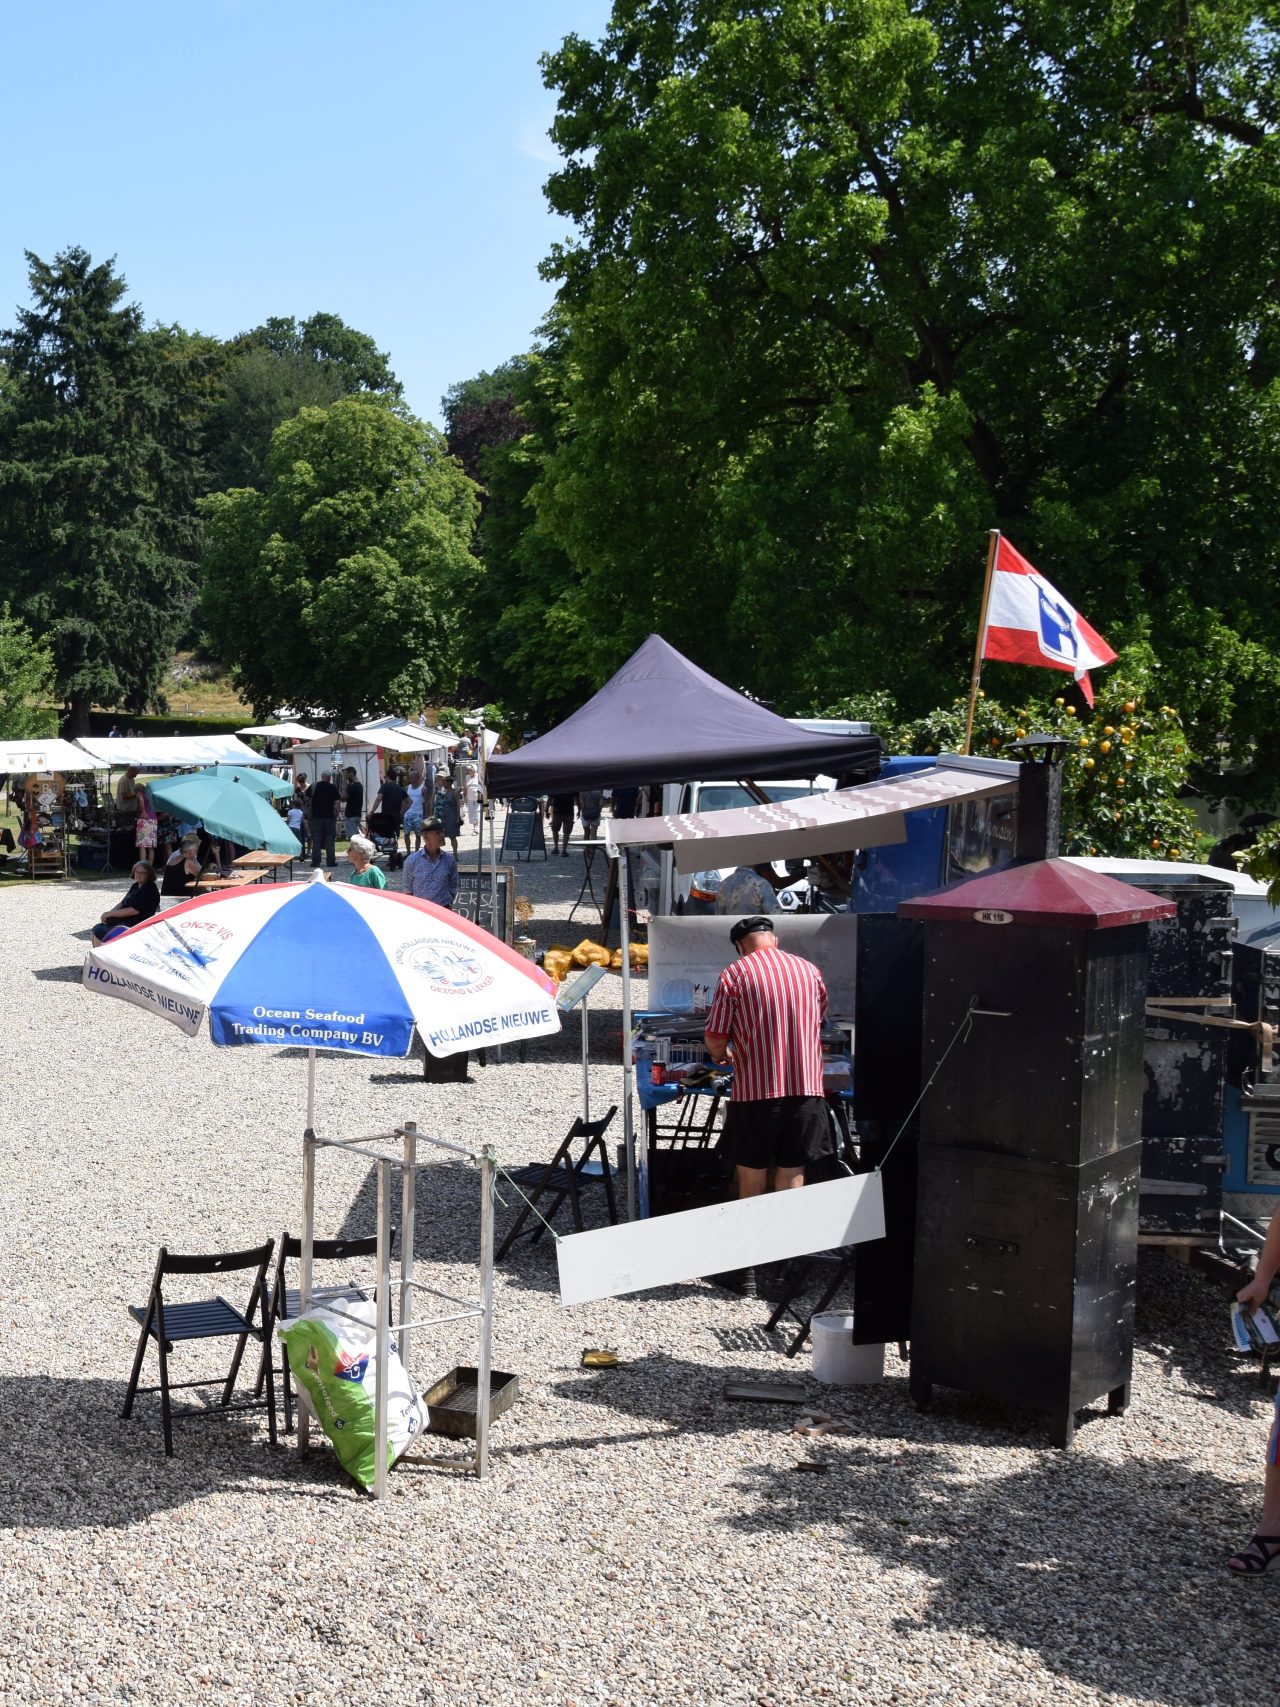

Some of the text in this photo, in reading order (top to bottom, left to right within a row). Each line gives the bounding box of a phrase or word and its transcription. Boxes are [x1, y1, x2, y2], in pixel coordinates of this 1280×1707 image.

[180, 921, 233, 941] ONZE VIS
[88, 966, 200, 1024] HOLLANDSE NIEUWE
[430, 985, 466, 995] GEZOND
[473, 975, 495, 993] LEKKER
[253, 1006, 365, 1025] Ocean Seafood
[232, 1023, 384, 1047] Trading Company BV
[429, 1009, 552, 1047] HOLLANDSE NIEUWE
